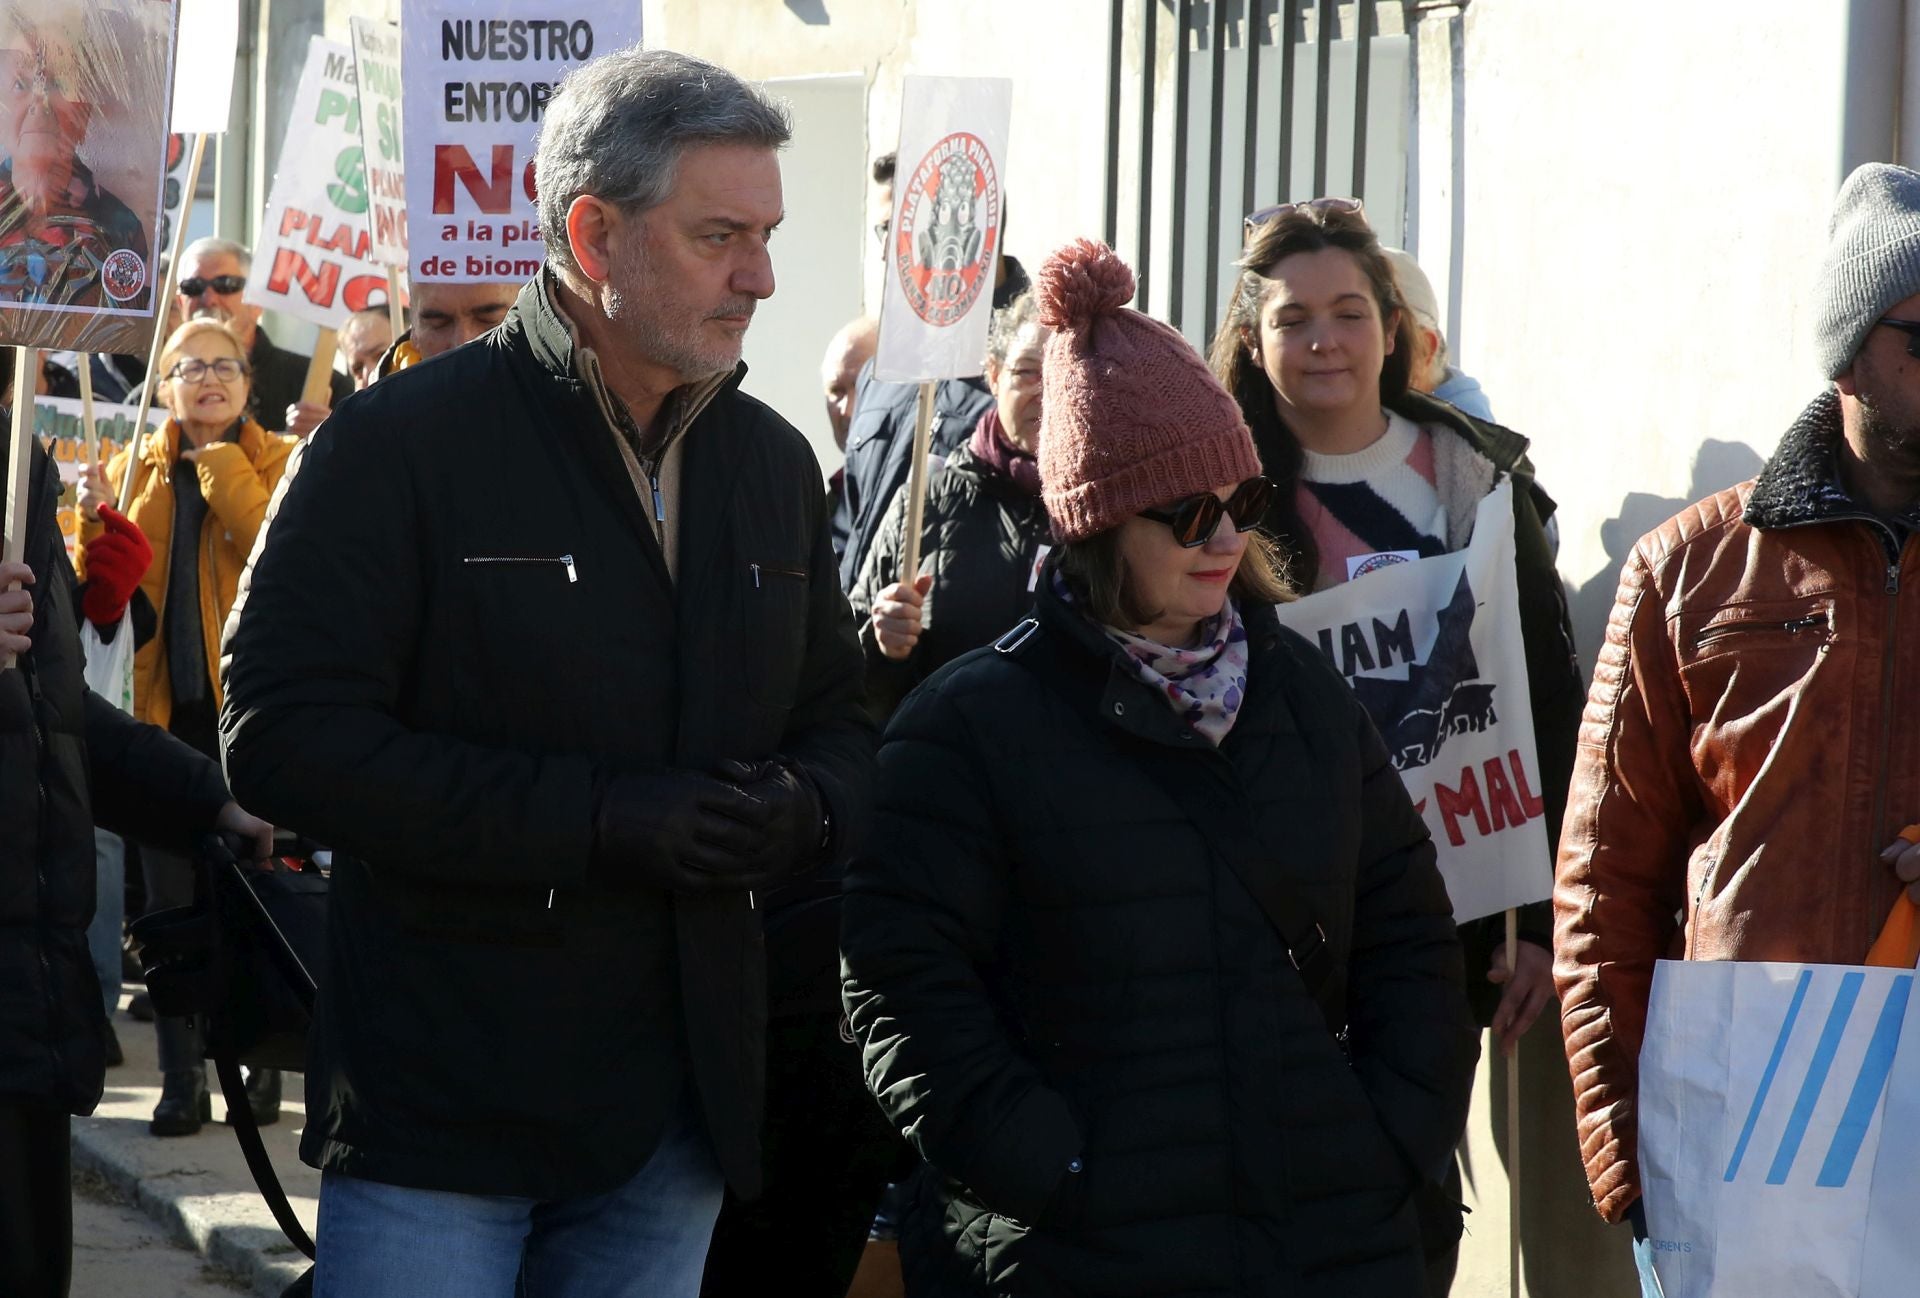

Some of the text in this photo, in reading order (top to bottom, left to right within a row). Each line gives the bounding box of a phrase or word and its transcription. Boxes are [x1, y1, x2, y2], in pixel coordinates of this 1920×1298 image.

[442, 19, 594, 61] NUESTRO
[444, 82, 557, 123] ENTOR
[433, 144, 538, 215] N
[441, 225, 458, 241] a
[467, 220, 492, 241] la
[420, 255, 457, 276] de
[929, 273, 962, 302] NO
[1434, 748, 1545, 847] MAL
